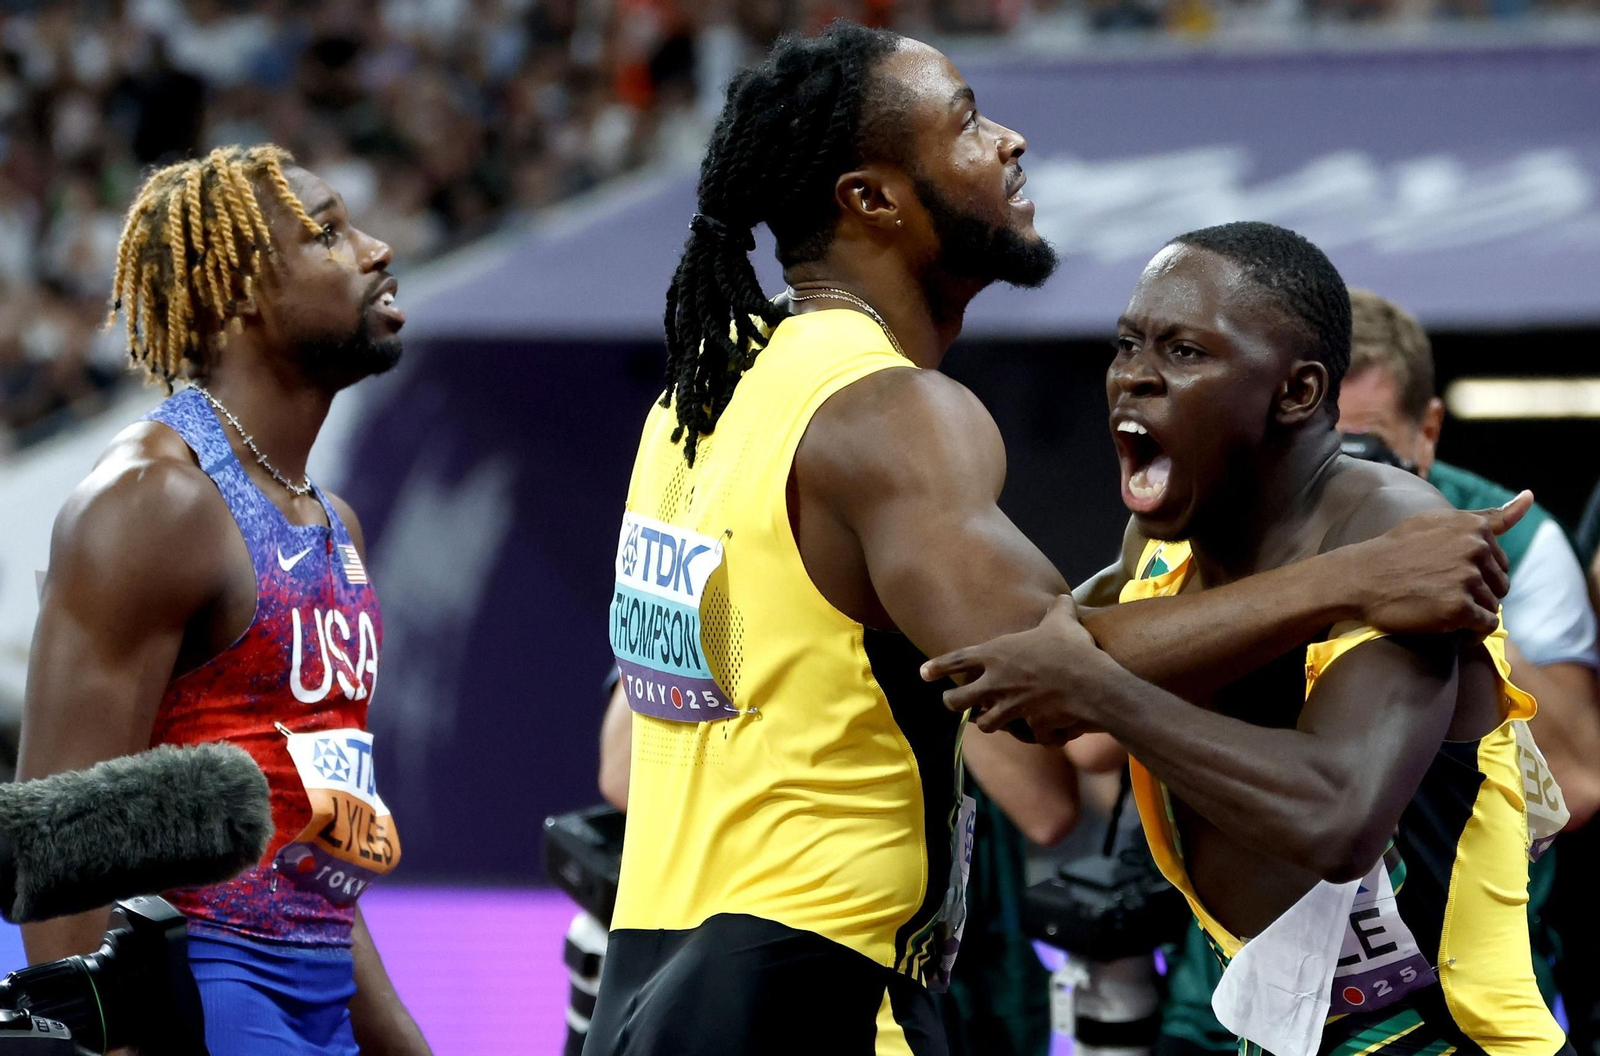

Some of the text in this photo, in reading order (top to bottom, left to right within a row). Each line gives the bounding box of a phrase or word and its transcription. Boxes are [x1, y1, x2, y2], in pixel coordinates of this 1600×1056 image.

[640, 527, 711, 596] TDK
[290, 607, 378, 705] USA
[613, 592, 701, 670] THOMPSON
[317, 796, 394, 866] LYLES
